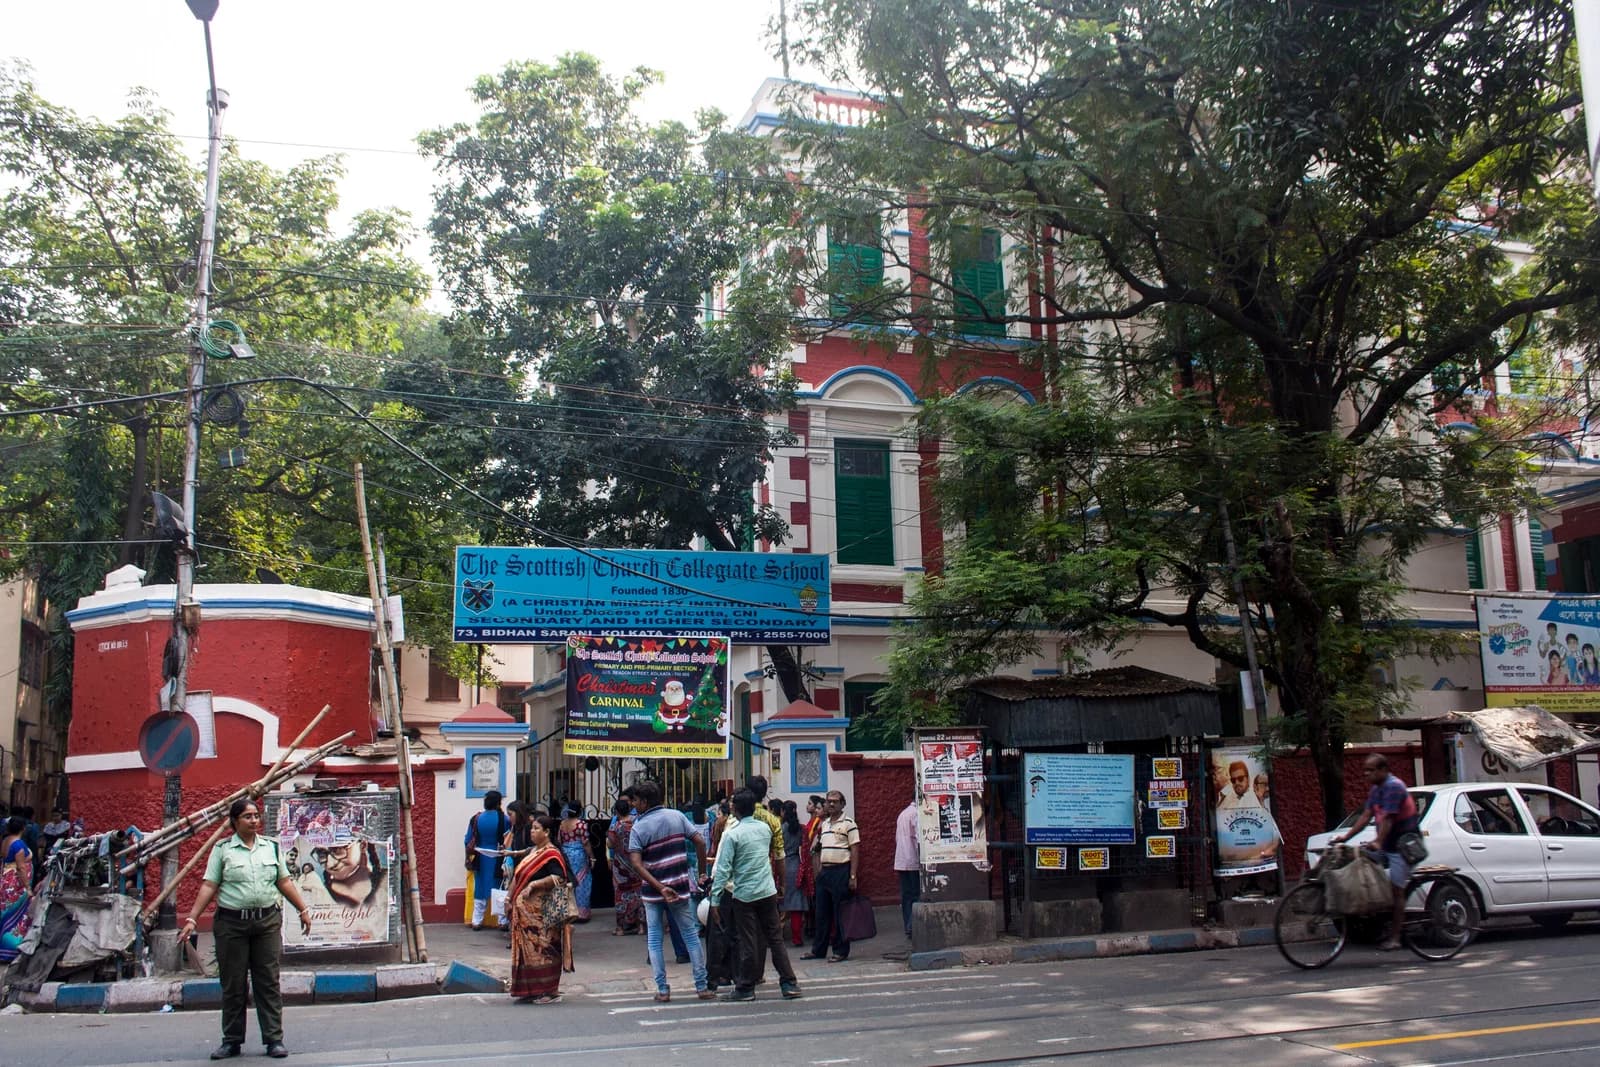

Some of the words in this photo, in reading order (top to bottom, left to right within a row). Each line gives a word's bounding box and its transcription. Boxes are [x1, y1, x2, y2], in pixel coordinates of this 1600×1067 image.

[461, 552, 498, 579] The
[505, 554, 586, 582] Scottish
[593, 556, 659, 582] Church
[666, 557, 757, 583] Collegiate
[763, 559, 825, 583] School
[611, 586, 658, 596] Founded
[662, 586, 688, 596] 1830
[502, 599, 517, 608] (A
[523, 598, 605, 607] CHRISTIAN
[610, 600, 683, 608] MINORITY
[534, 608, 577, 616] Under
[583, 608, 640, 616] Diocese
[664, 609, 728, 618] Calcutta,
[468, 617, 584, 625] SECONDARY
[590, 617, 629, 625] AND
[711, 619, 818, 627] SECONDARY
[456, 629, 478, 638] 73,
[482, 629, 536, 637] BIDHAN
[763, 631, 828, 639] 2555-7006
[575, 647, 591, 660] The
[591, 649, 624, 662] Scottish
[624, 650, 653, 663] Church
[653, 651, 690, 664] Collegiate
[690, 652, 718, 664] School
[576, 673, 656, 695] Christmas
[589, 695, 645, 709] CARNIVAL
[568, 719, 590, 727] Christmas
[589, 720, 607, 728] Cultural
[1149, 781, 1159, 789] NO
[1159, 780, 1185, 789] PARKING
[1169, 790, 1185, 798] GST
